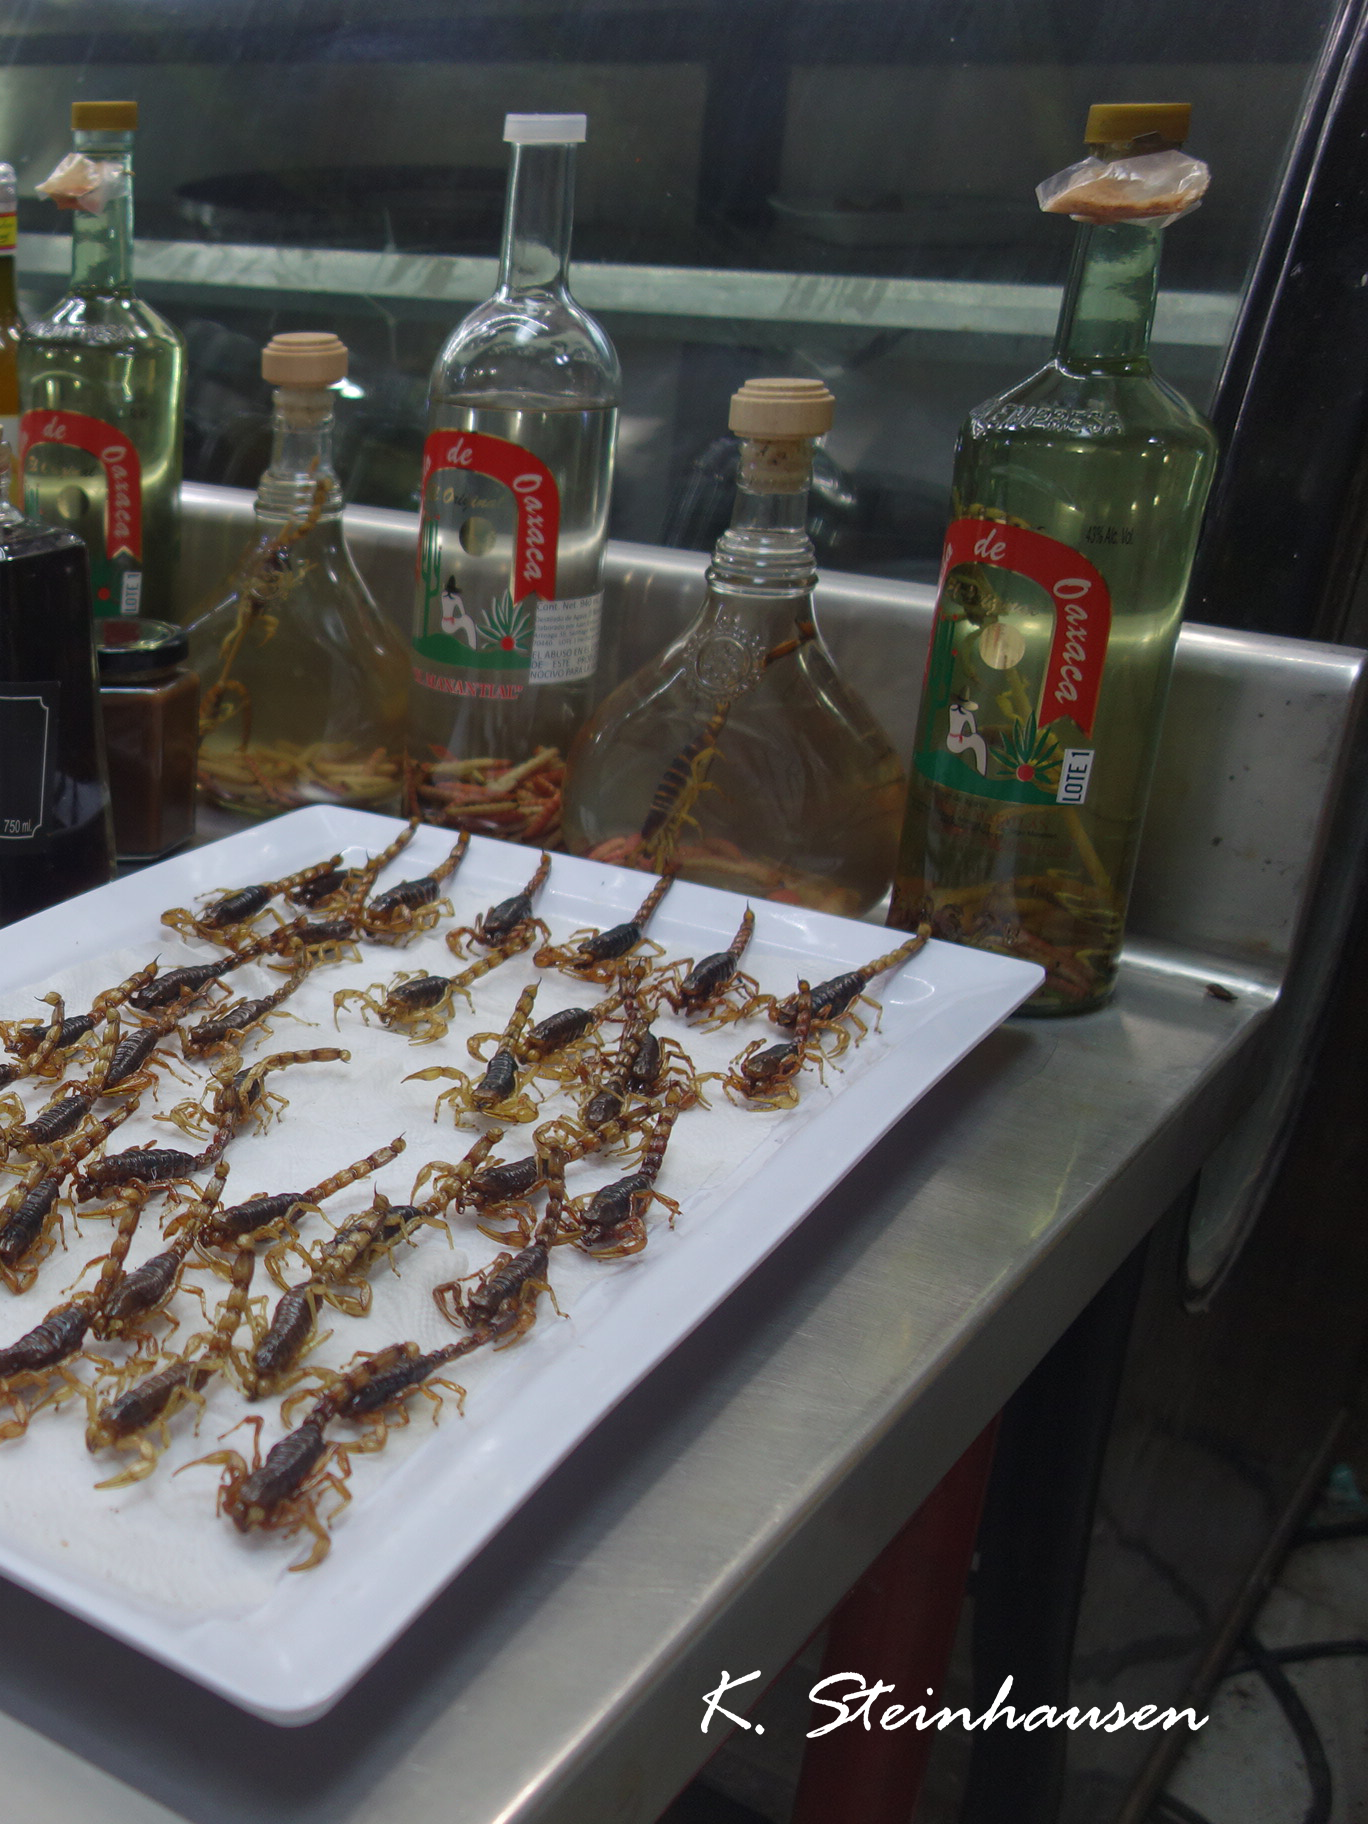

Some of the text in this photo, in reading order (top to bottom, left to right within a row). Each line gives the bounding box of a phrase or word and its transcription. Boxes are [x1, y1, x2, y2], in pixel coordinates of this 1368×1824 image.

[42, 415, 67, 439] de
[101, 445, 132, 539] Oaxaca
[447, 438, 544, 581] de Oaxaca
[973, 528, 1007, 561] de
[1052, 577, 1092, 706] Oaxaca
[3, 818, 21, 834] 750
[1062, 762, 1089, 803] LOTE
